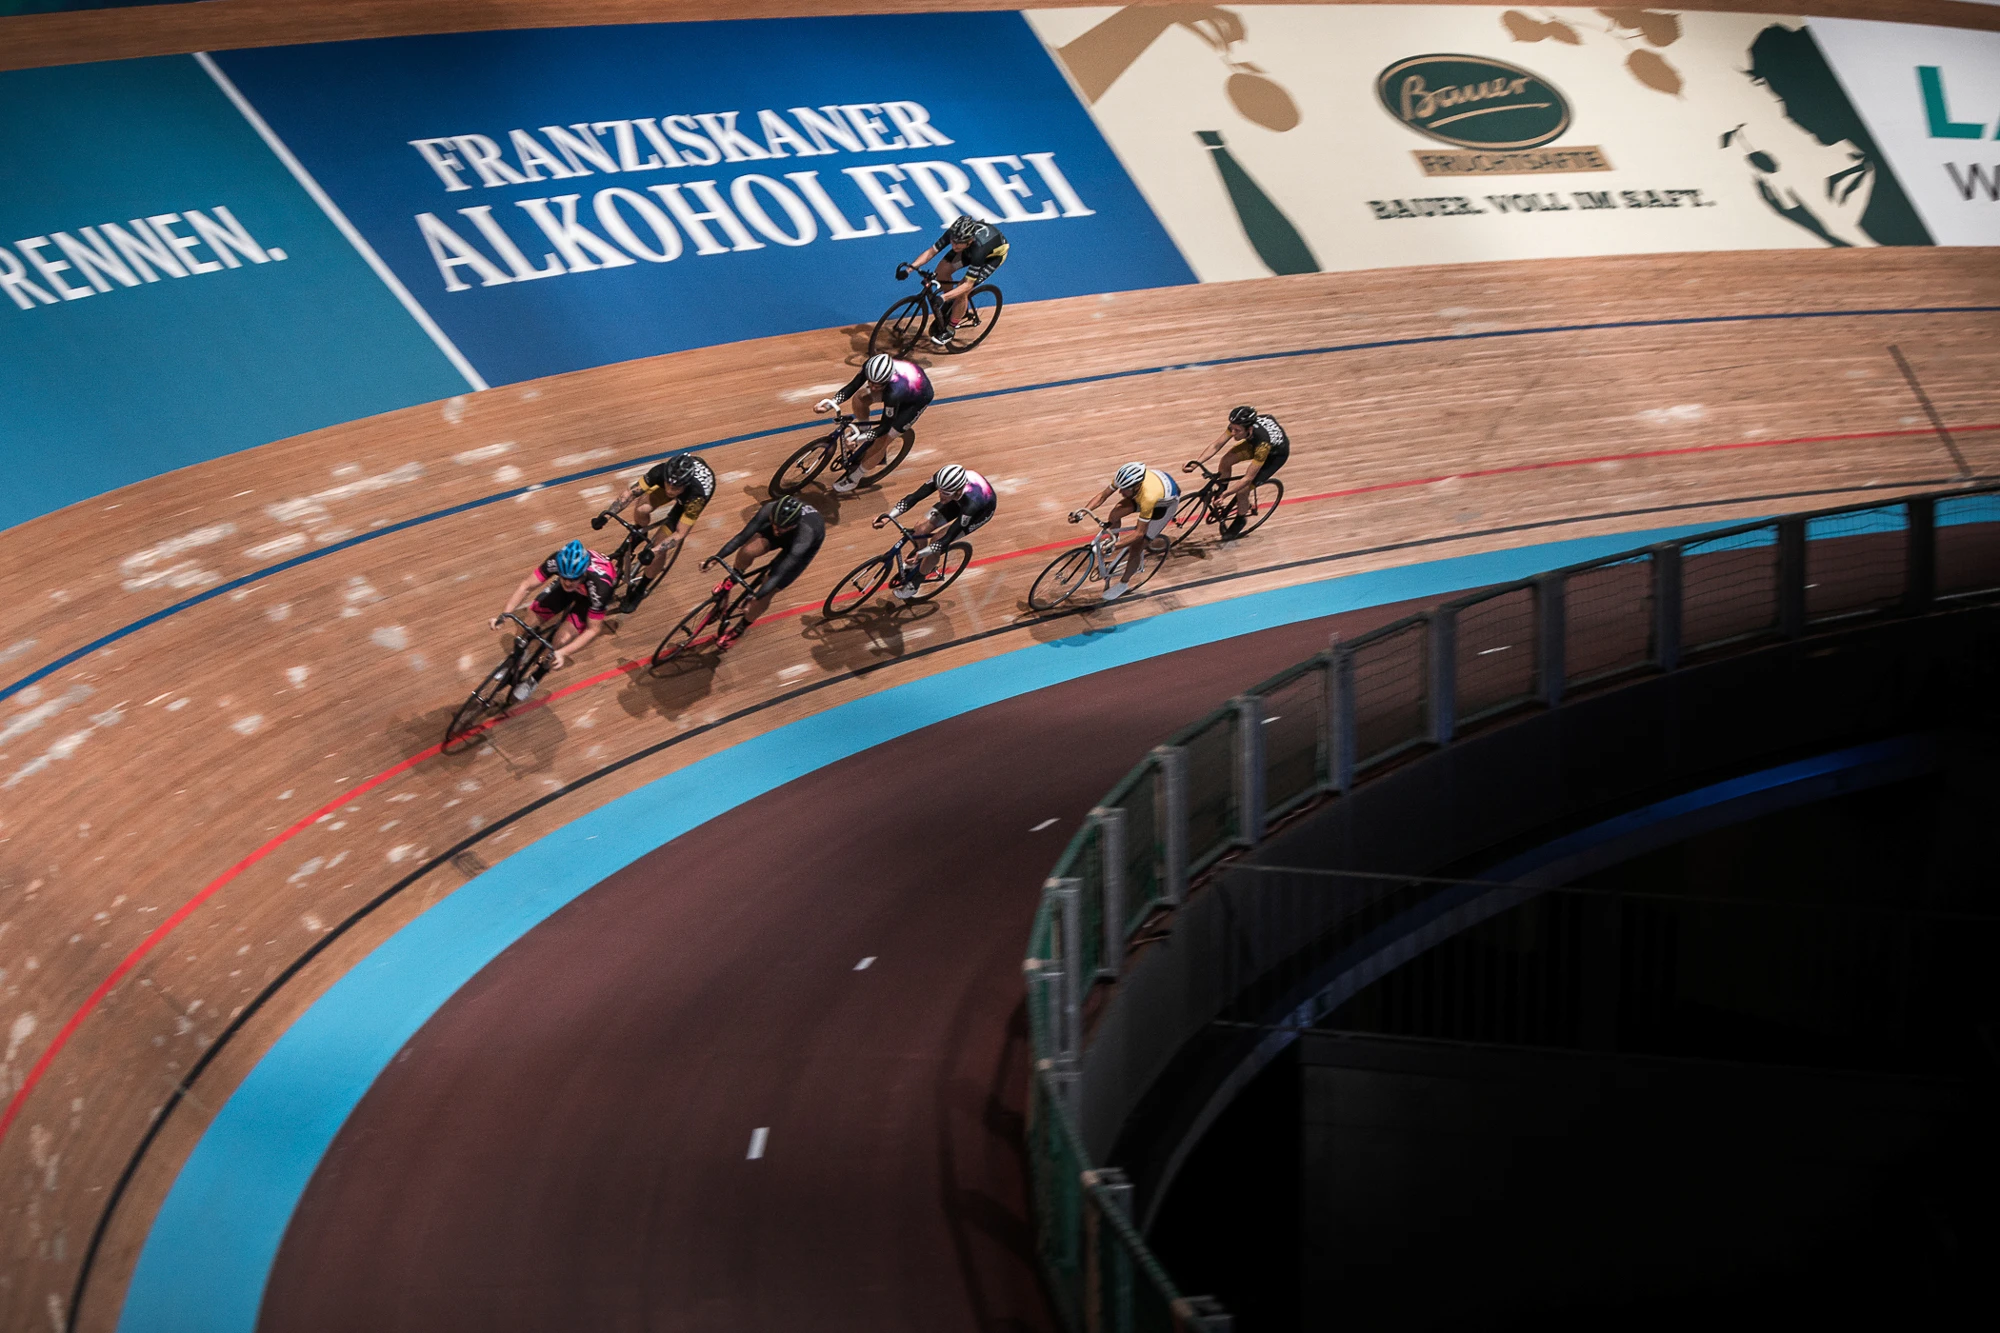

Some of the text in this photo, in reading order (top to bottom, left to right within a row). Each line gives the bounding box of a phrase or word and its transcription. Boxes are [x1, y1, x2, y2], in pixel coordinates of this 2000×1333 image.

[1401, 75, 1532, 121] Bauer
[1914, 65, 2000, 141] L
[408, 101, 955, 192] FRANZISKANER
[414, 152, 1096, 292] ALKOHOLFREI
[1366, 188, 1717, 220] BAUER. VOLL IM SAFT.
[0, 206, 288, 310] RENNEN.
